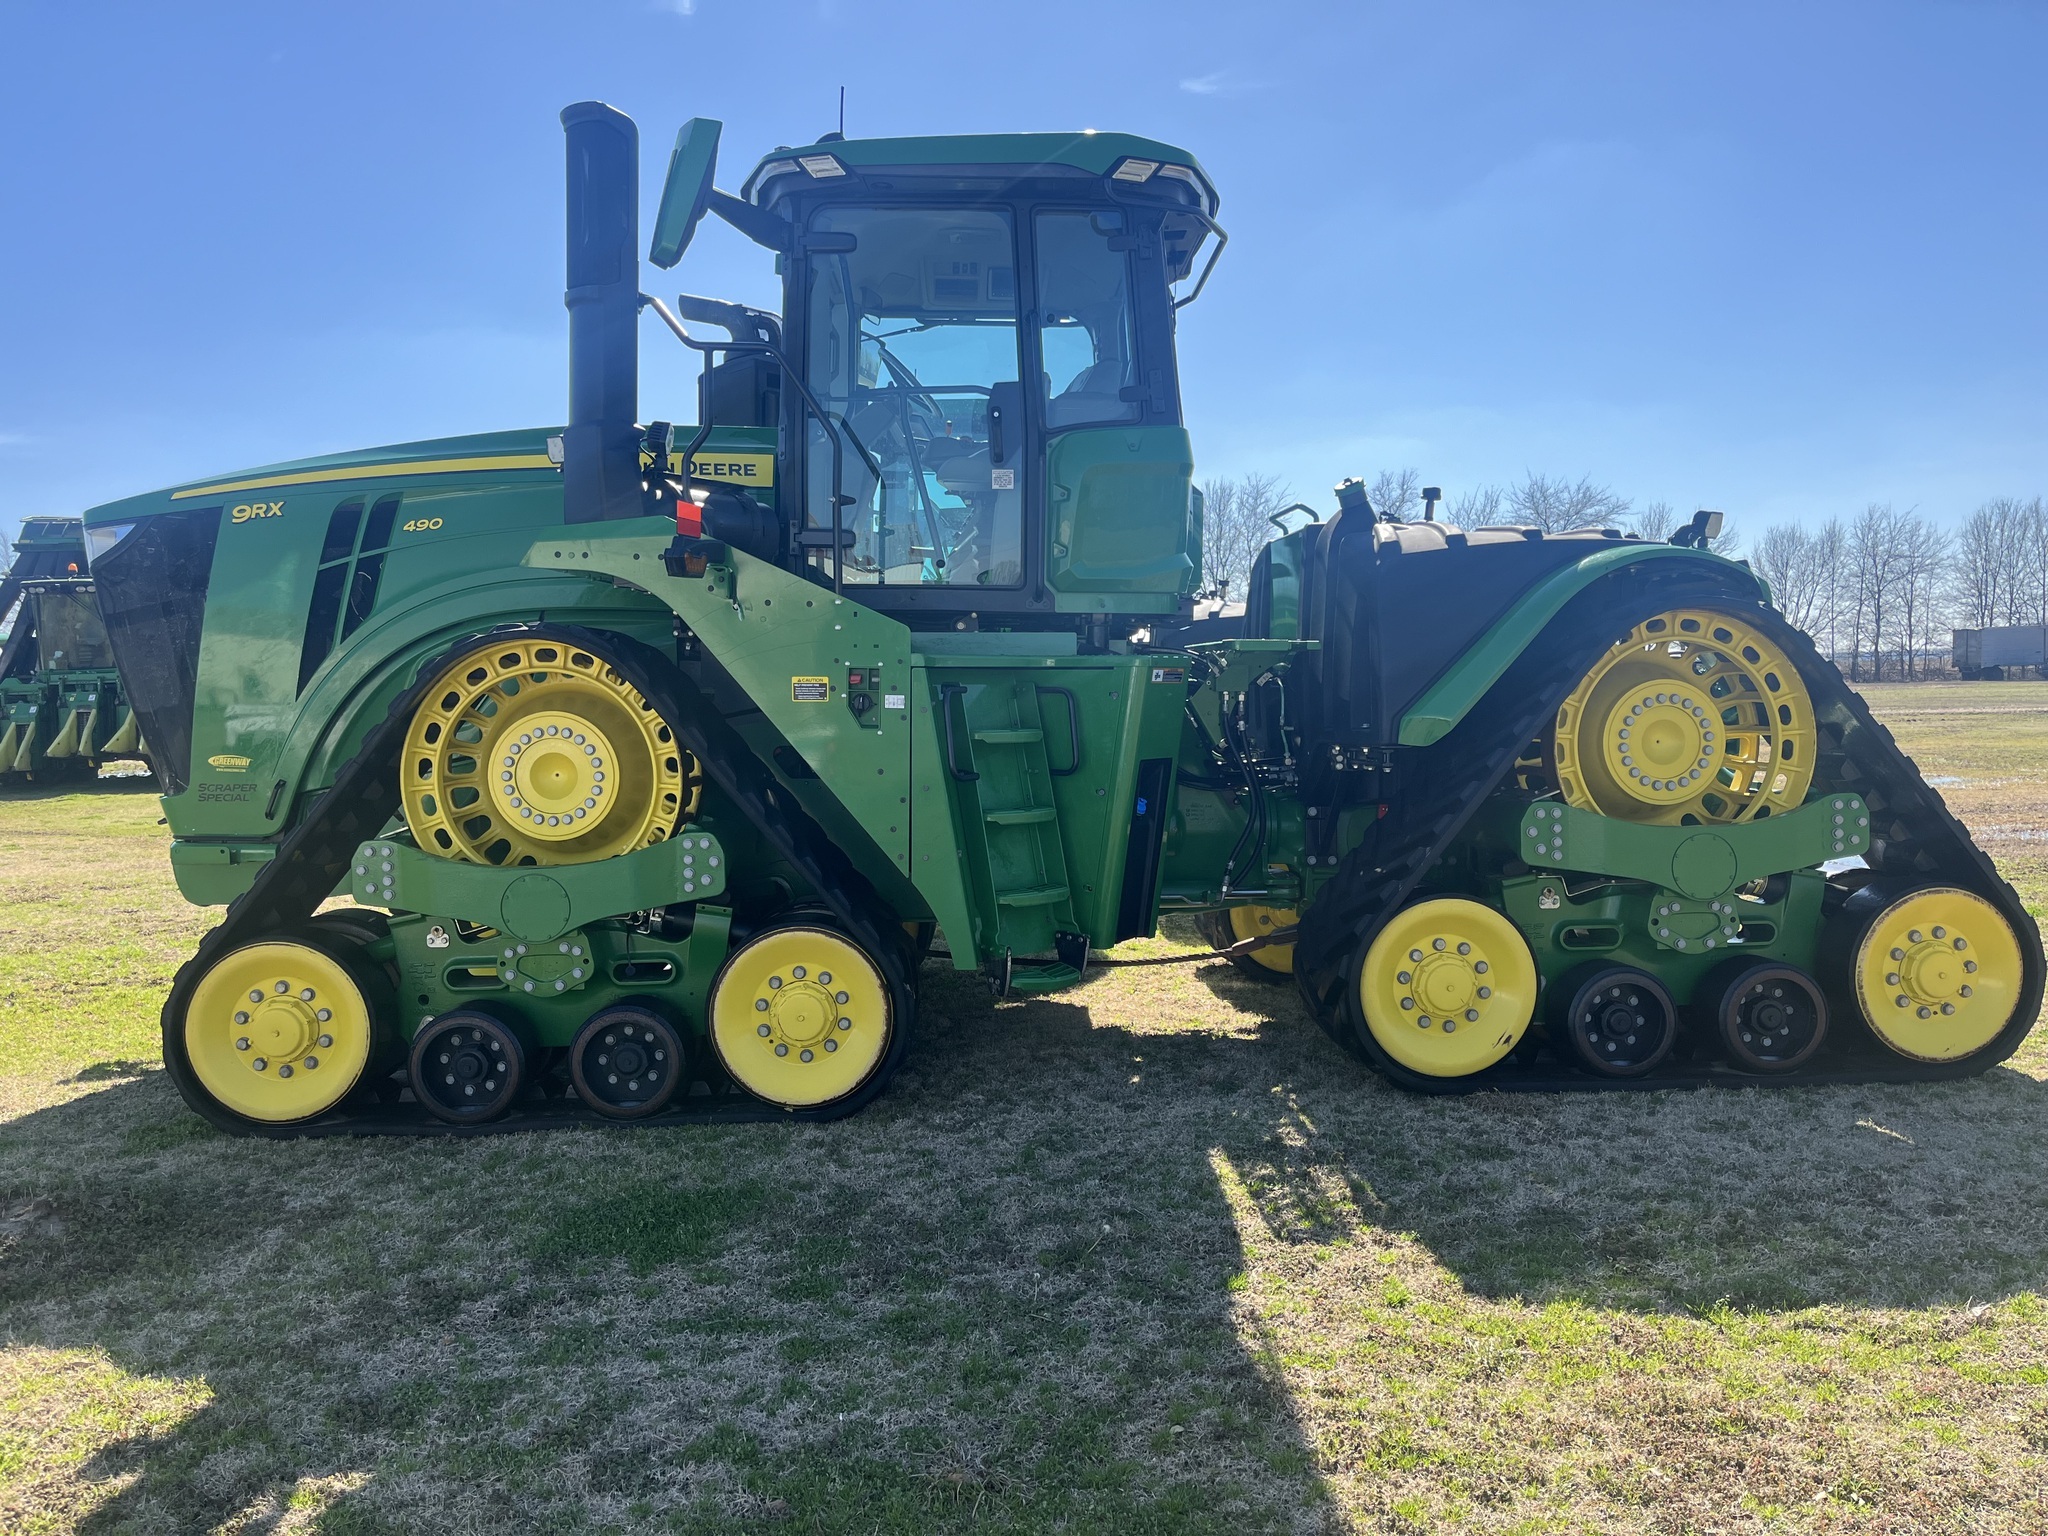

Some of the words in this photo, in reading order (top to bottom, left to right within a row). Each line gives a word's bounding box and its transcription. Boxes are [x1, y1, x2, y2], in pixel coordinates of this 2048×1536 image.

[231, 501, 285, 523] 9RX
[403, 517, 443, 531] 490
[213, 757, 251, 766] GREENWAY
[198, 783, 257, 792] SCRAPER
[198, 793, 250, 802] SPECIAL
